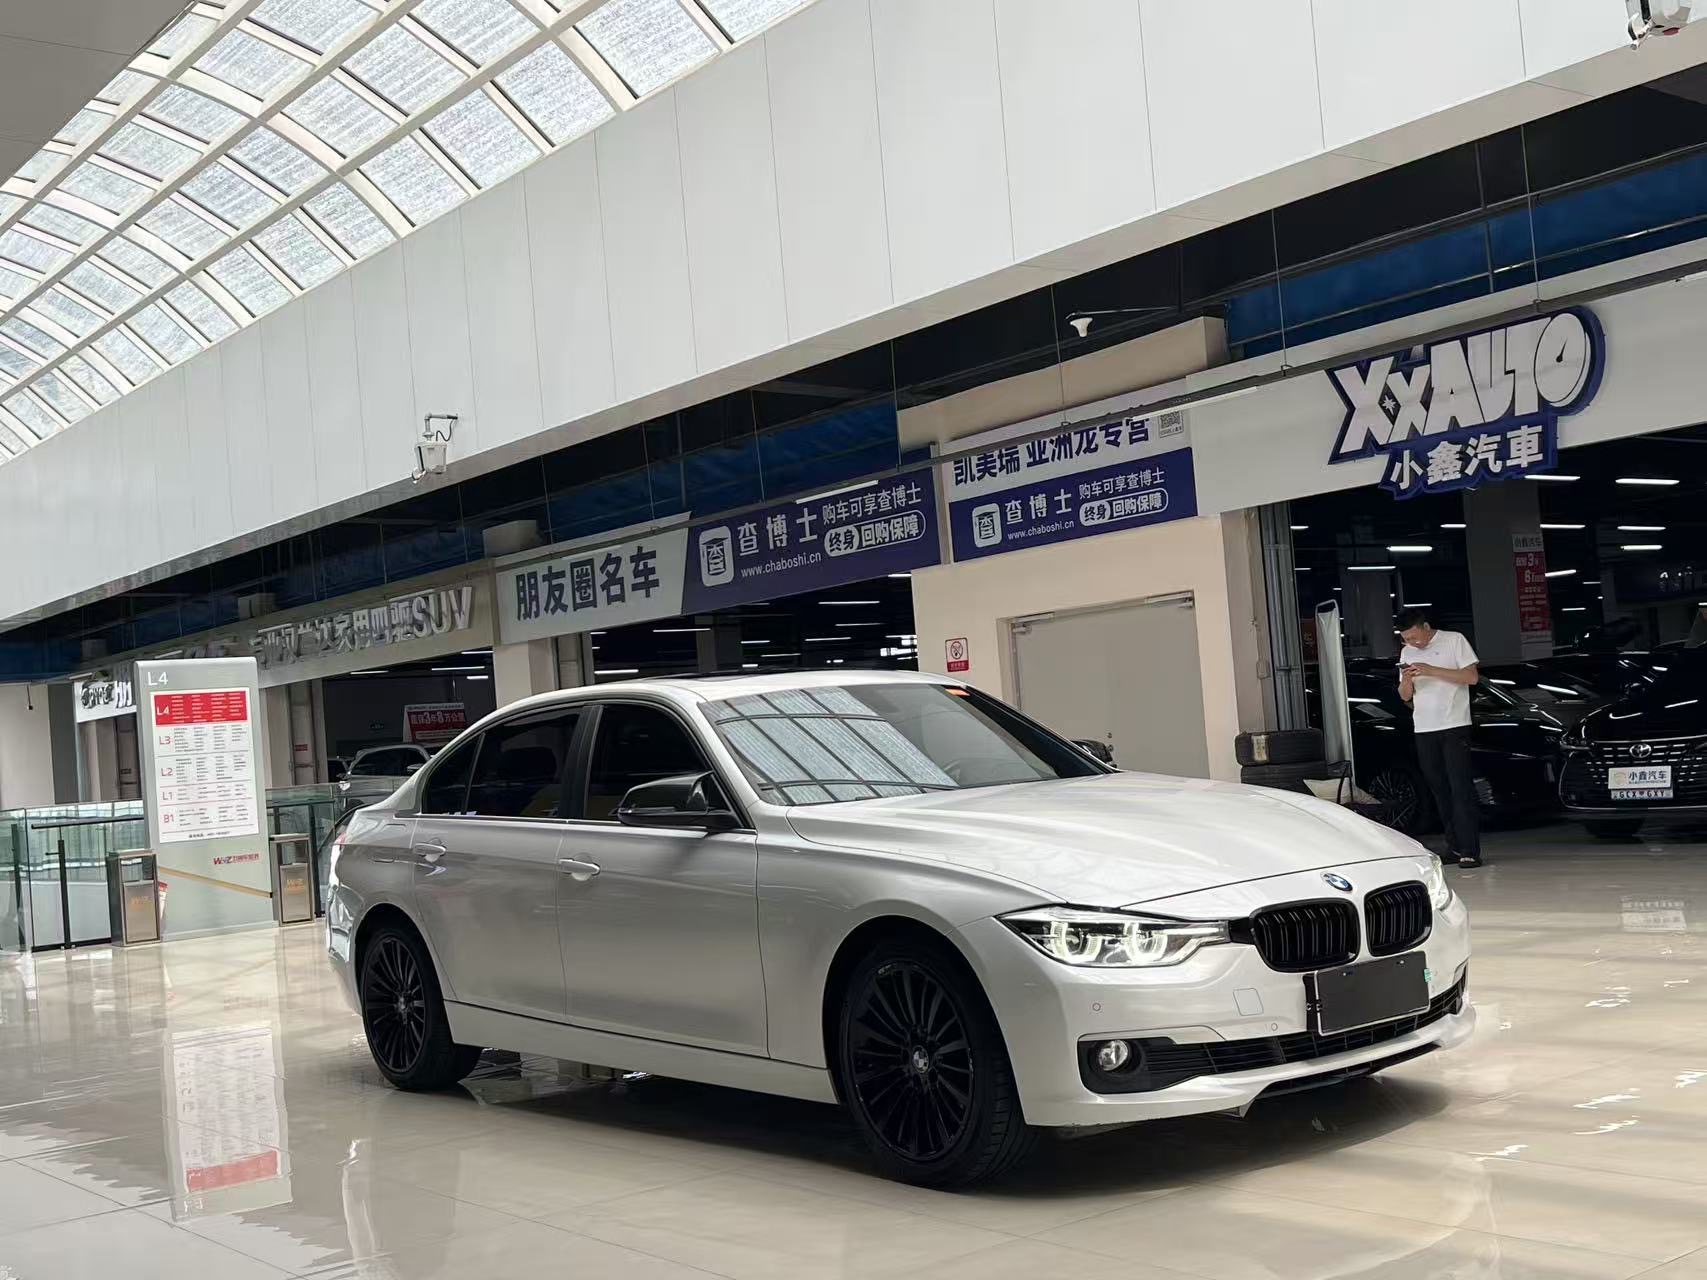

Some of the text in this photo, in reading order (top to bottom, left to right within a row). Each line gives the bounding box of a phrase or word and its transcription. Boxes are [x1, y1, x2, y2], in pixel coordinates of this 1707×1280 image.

[1390, 425, 1544, 490] 小鑫汽車
[1078, 467, 1165, 500] 购车可享查博士
[822, 482, 922, 526] 购车可享查博士
[1004, 488, 1072, 525] 查博士
[737, 507, 819, 556] 查博士
[1007, 520, 1075, 540] www.chaboshi.cn
[740, 551, 822, 578] www.chaboshi.cn
[515, 546, 660, 621] 朋友圈名车
[147, 672, 169, 685] L4
[156, 705, 170, 716] L4
[159, 735, 171, 745] L3
[161, 768, 173, 776] L2
[162, 792, 173, 800] L1
[163, 814, 174, 823] B1
